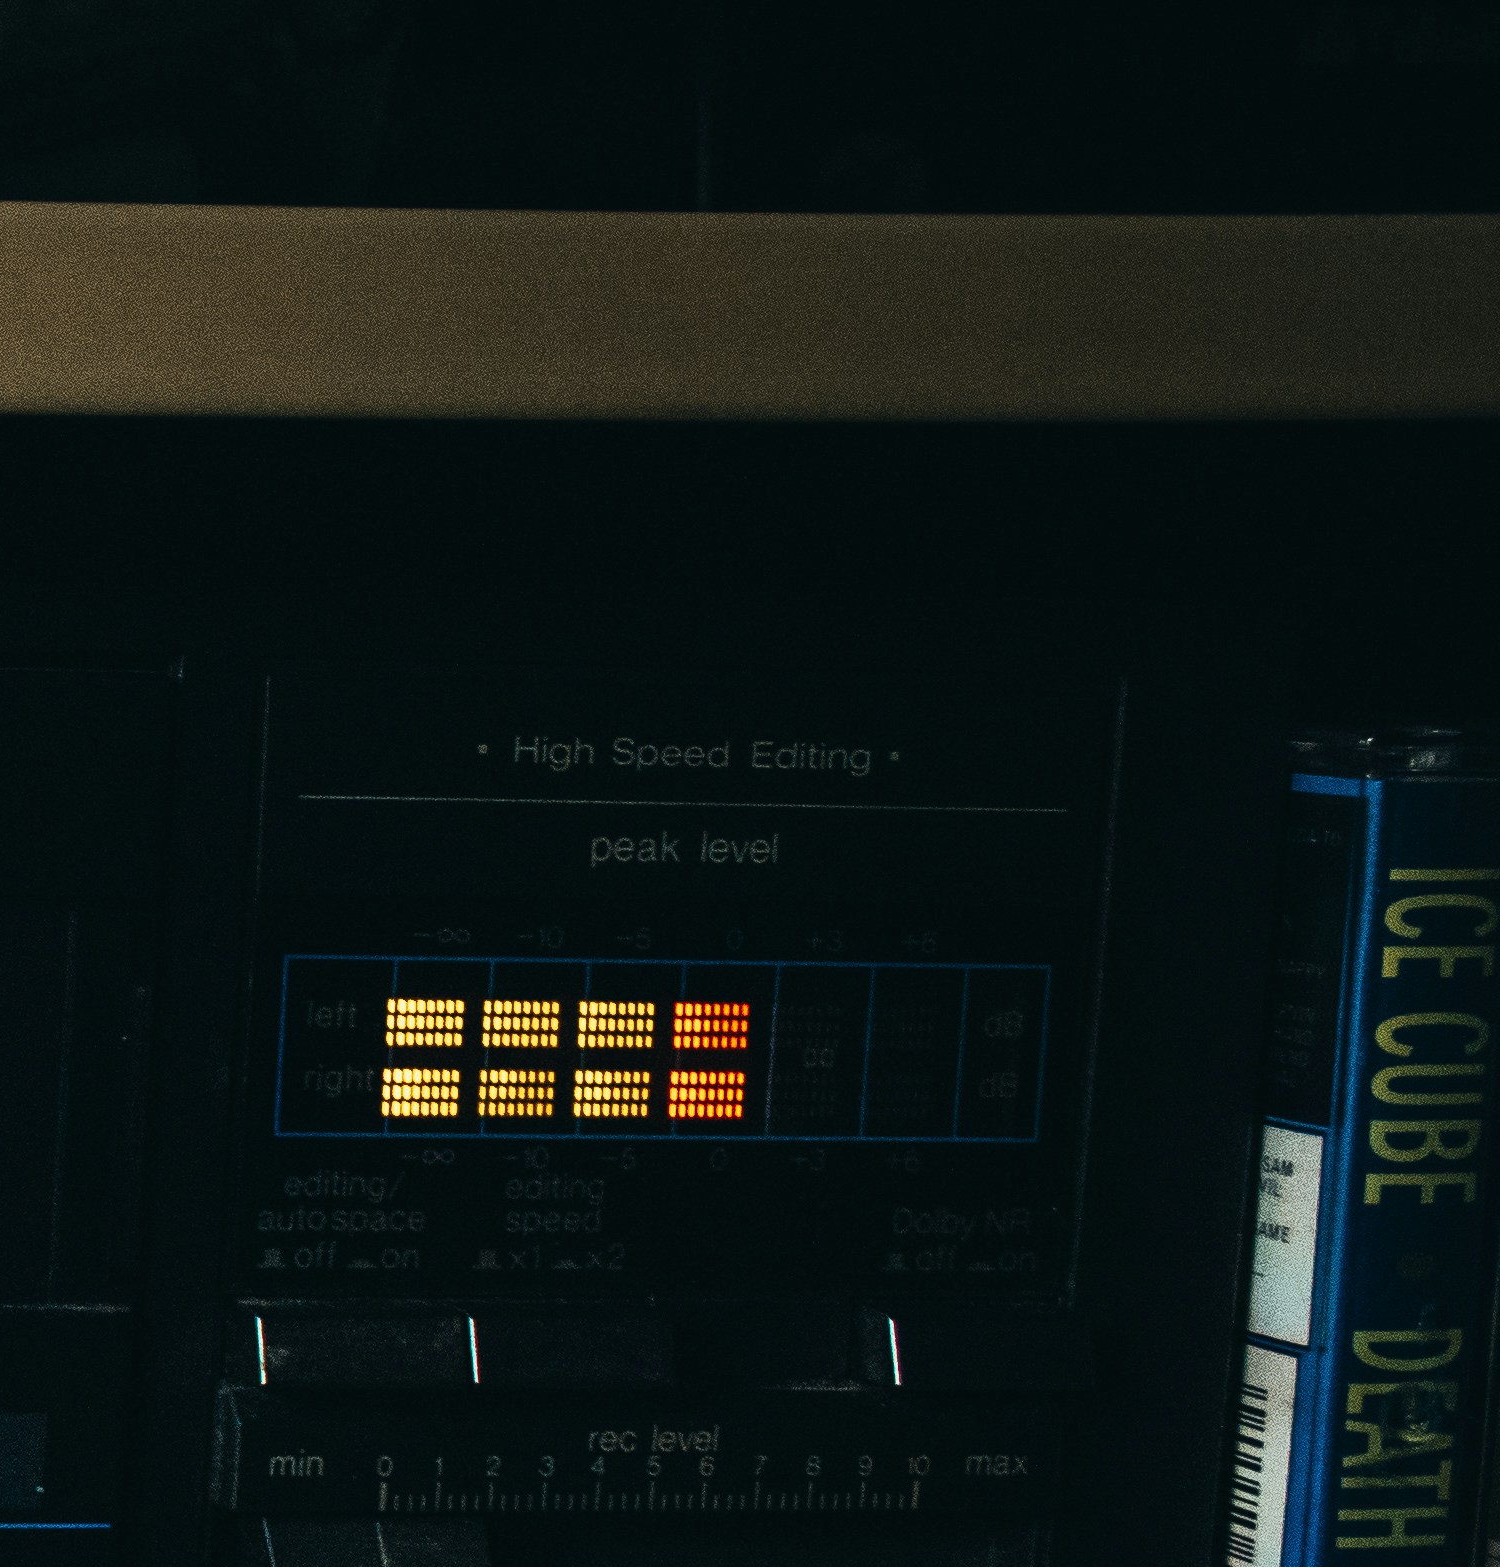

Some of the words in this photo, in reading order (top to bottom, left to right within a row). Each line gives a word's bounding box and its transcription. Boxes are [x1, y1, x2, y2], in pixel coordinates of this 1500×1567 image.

[514, 736, 595, 771] High
[613, 736, 730, 770] Speed
[751, 740, 871, 777] Editing
[591, 832, 679, 867] peak
[700, 833, 778, 864] level
[1380, 867, 1500, 980] ICE
[1363, 1011, 1490, 1206] CUBE
[589, 1430, 636, 1452] rec
[652, 1427, 719, 1452] level
[1334, 1328, 1463, 1550] DEATH
[268, 1450, 325, 1478] min
[377, 1455, 393, 1477] 0
[435, 1457, 443, 1475] 1
[486, 1455, 501, 1477] 2
[539, 1455, 555, 1477] 3
[590, 1455, 606, 1476] 4
[648, 1455, 661, 1477] 5
[699, 1456, 714, 1476] 6
[755, 1454, 768, 1475] 7
[806, 1455, 821, 1476] 8
[859, 1455, 873, 1476] 9
[908, 1454, 930, 1476] 10
[967, 1455, 1026, 1475] max
